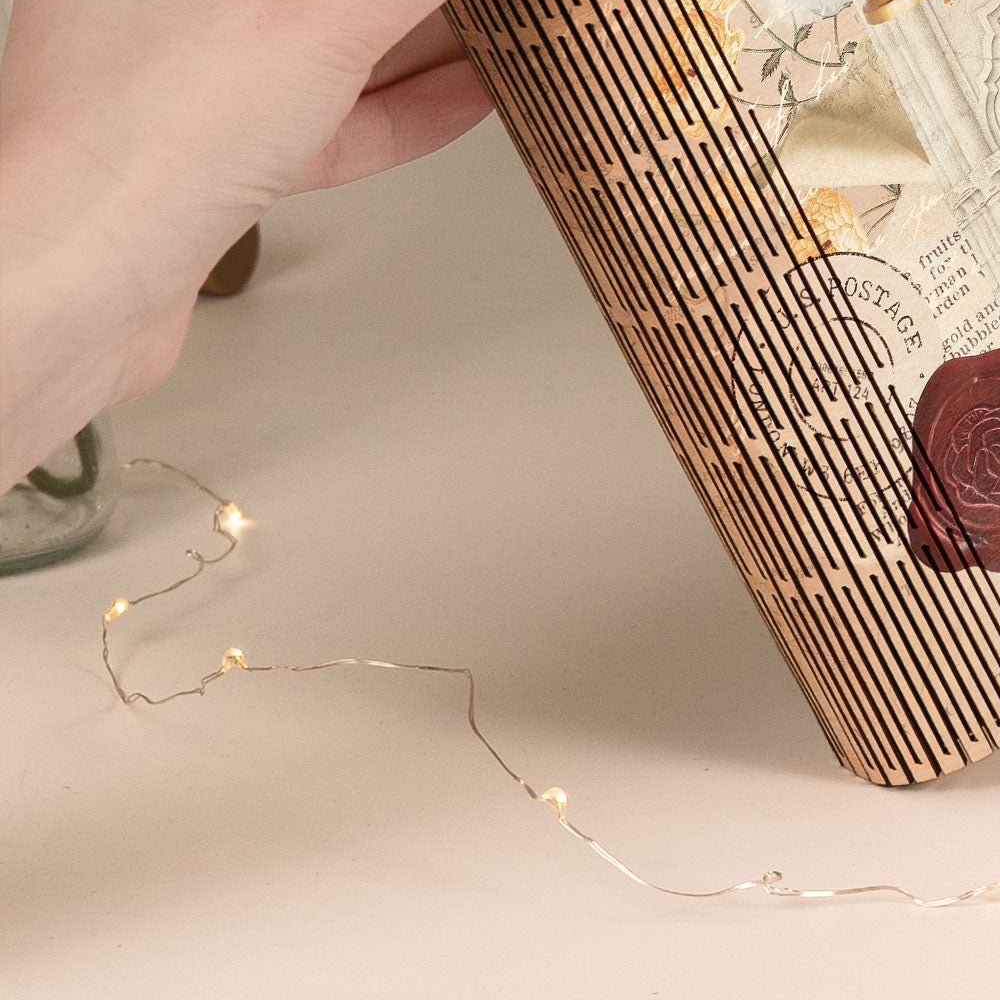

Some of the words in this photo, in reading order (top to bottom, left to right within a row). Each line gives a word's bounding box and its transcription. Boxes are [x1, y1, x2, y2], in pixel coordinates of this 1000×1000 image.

[918, 230, 962, 268] fruits
[828, 276, 923, 354] POSTAGE
[941, 310, 975, 354] gold
